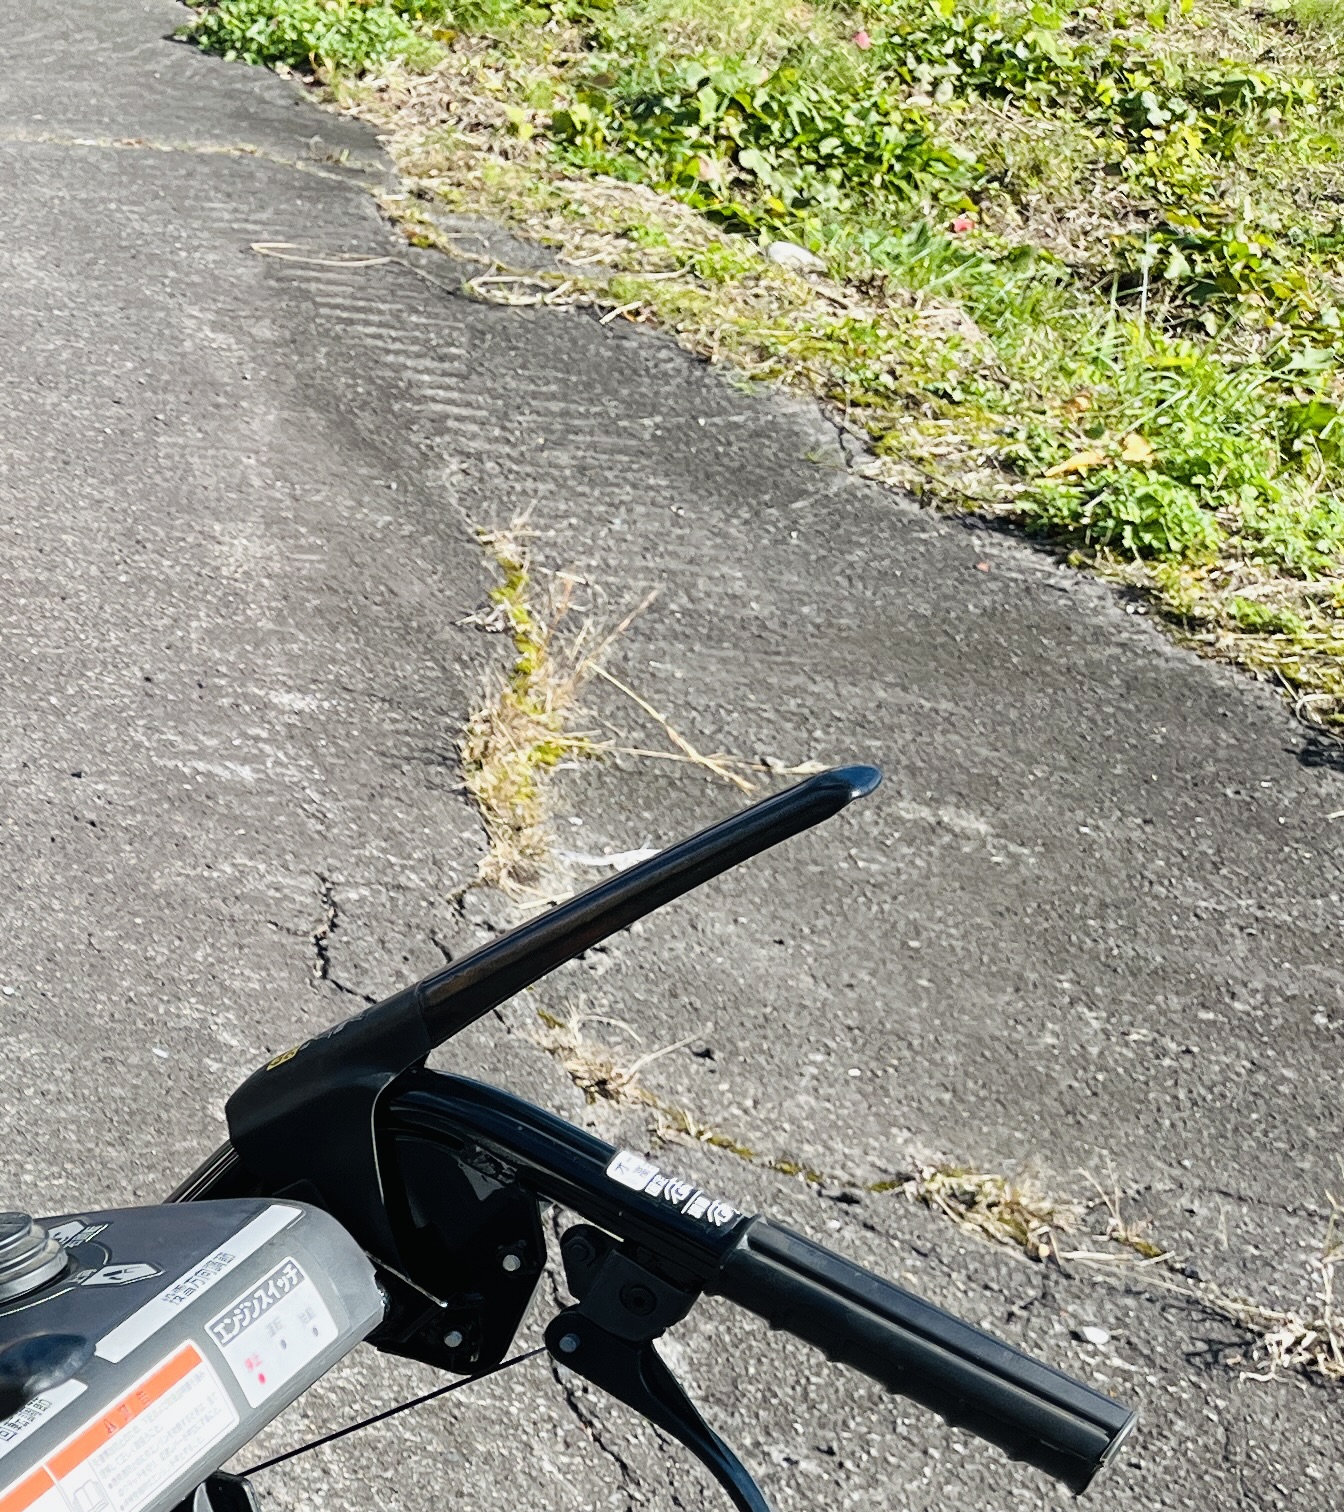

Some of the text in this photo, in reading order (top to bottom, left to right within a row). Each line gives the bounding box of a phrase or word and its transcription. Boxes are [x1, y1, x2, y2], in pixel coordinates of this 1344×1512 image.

[213, 1264, 300, 1344] エンジンスイッチ
